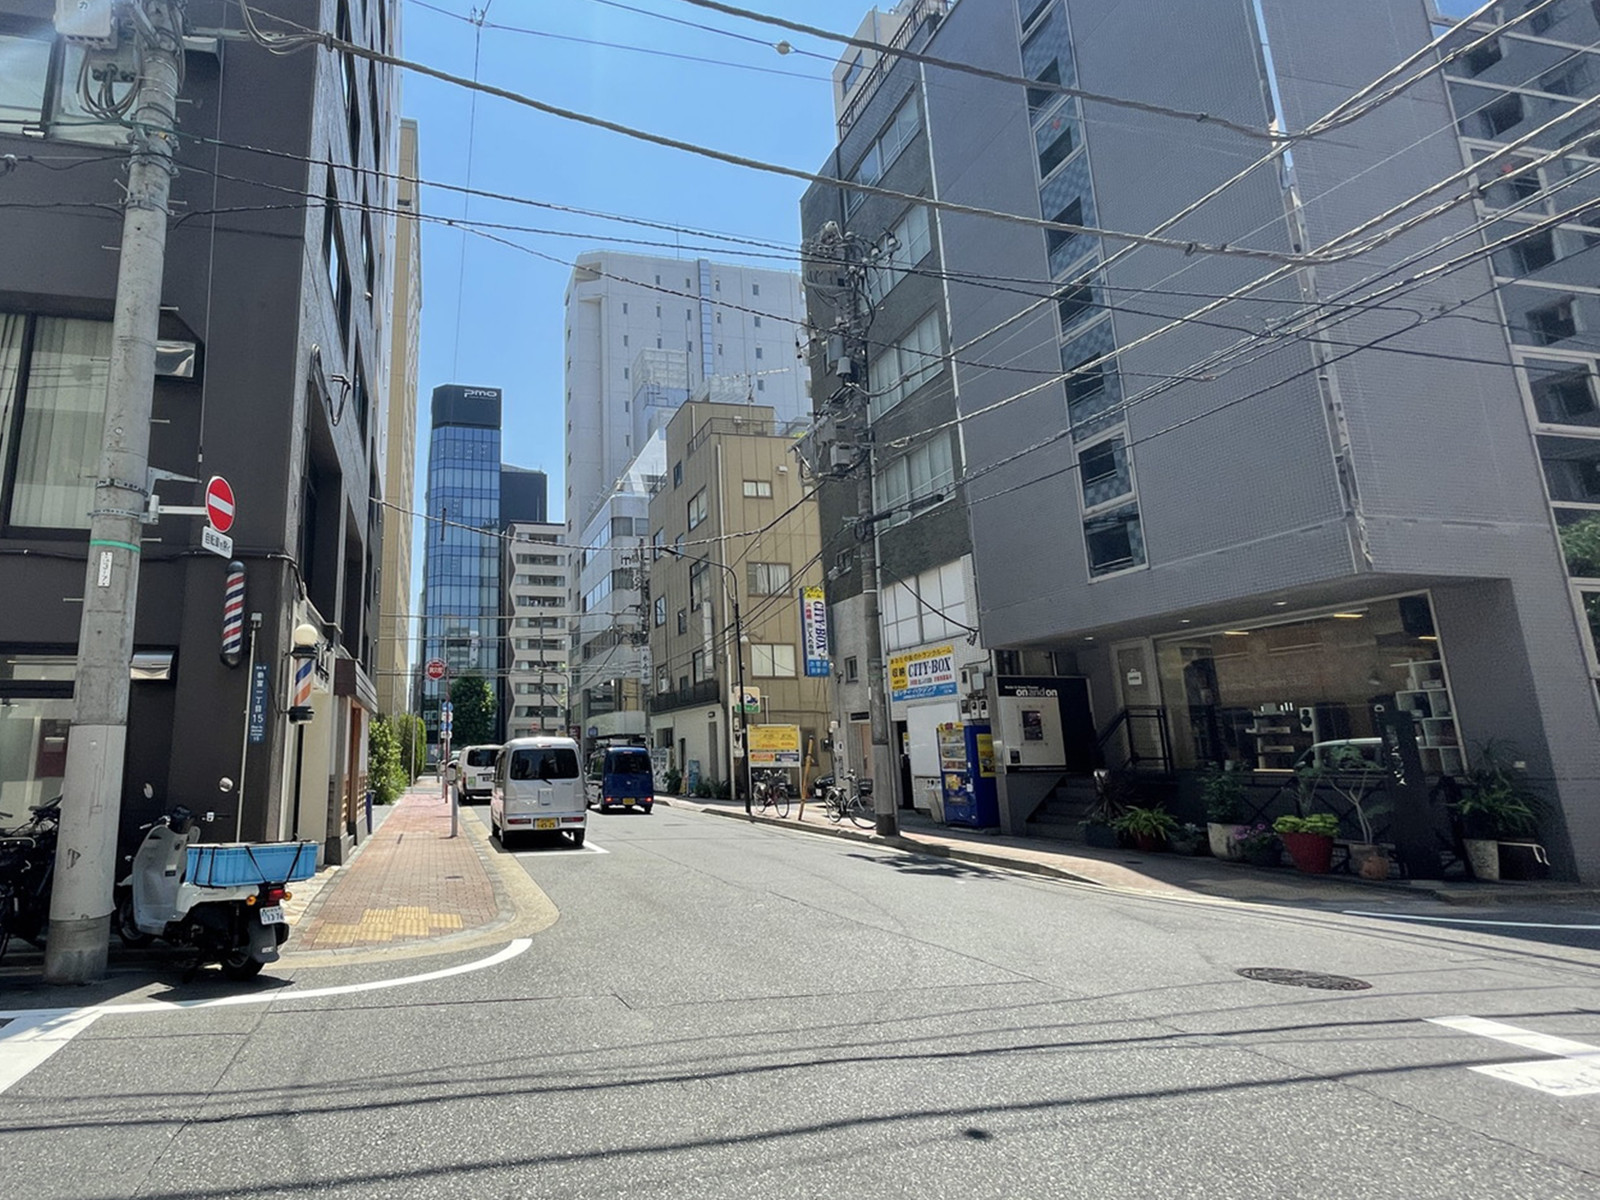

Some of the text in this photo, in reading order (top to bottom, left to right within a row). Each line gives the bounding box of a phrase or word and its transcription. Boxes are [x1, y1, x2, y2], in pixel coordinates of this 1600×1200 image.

[464, 389, 498, 399] pmo
[1016, 689, 1028, 697] on
[1045, 689, 1058, 697] on
[252, 714, 264, 723] 15
